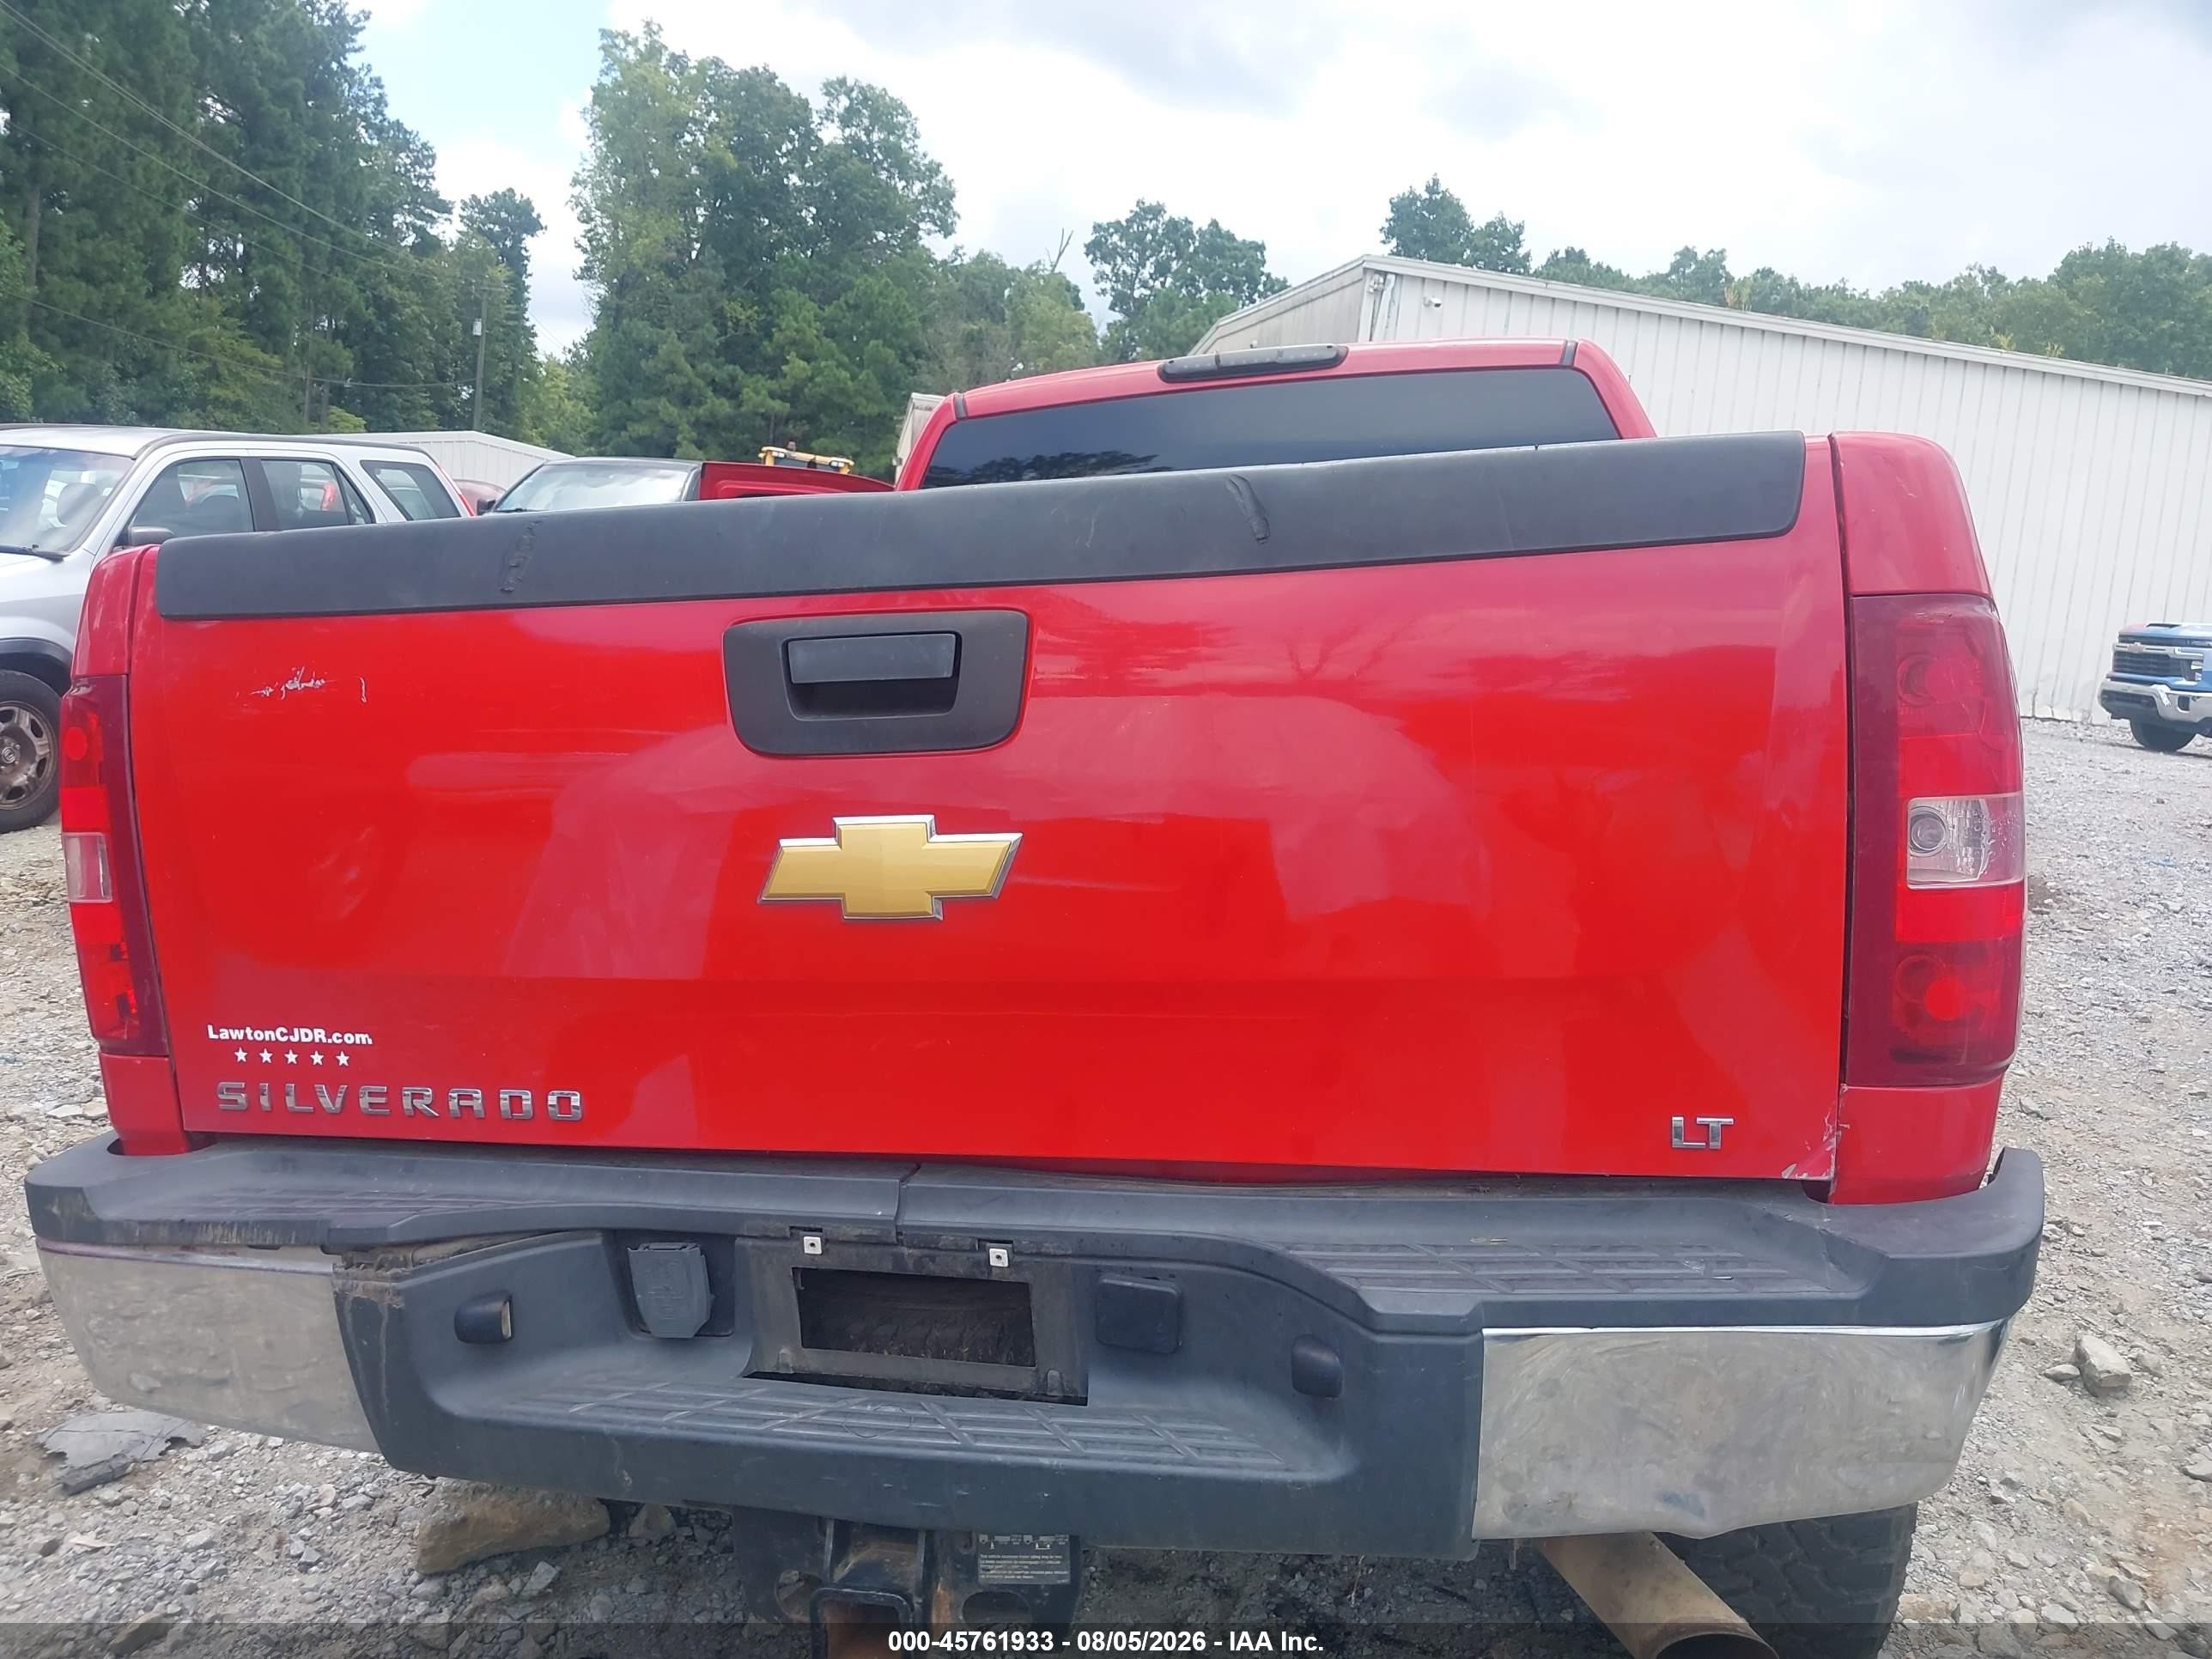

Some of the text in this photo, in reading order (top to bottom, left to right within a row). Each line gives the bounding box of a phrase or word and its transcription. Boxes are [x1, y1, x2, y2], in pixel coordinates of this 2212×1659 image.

[207, 1024, 373, 1045] LawtonCJDR.com
[216, 1081, 583, 1121] SILVERADO
[1671, 1116, 1734, 1150] LT
